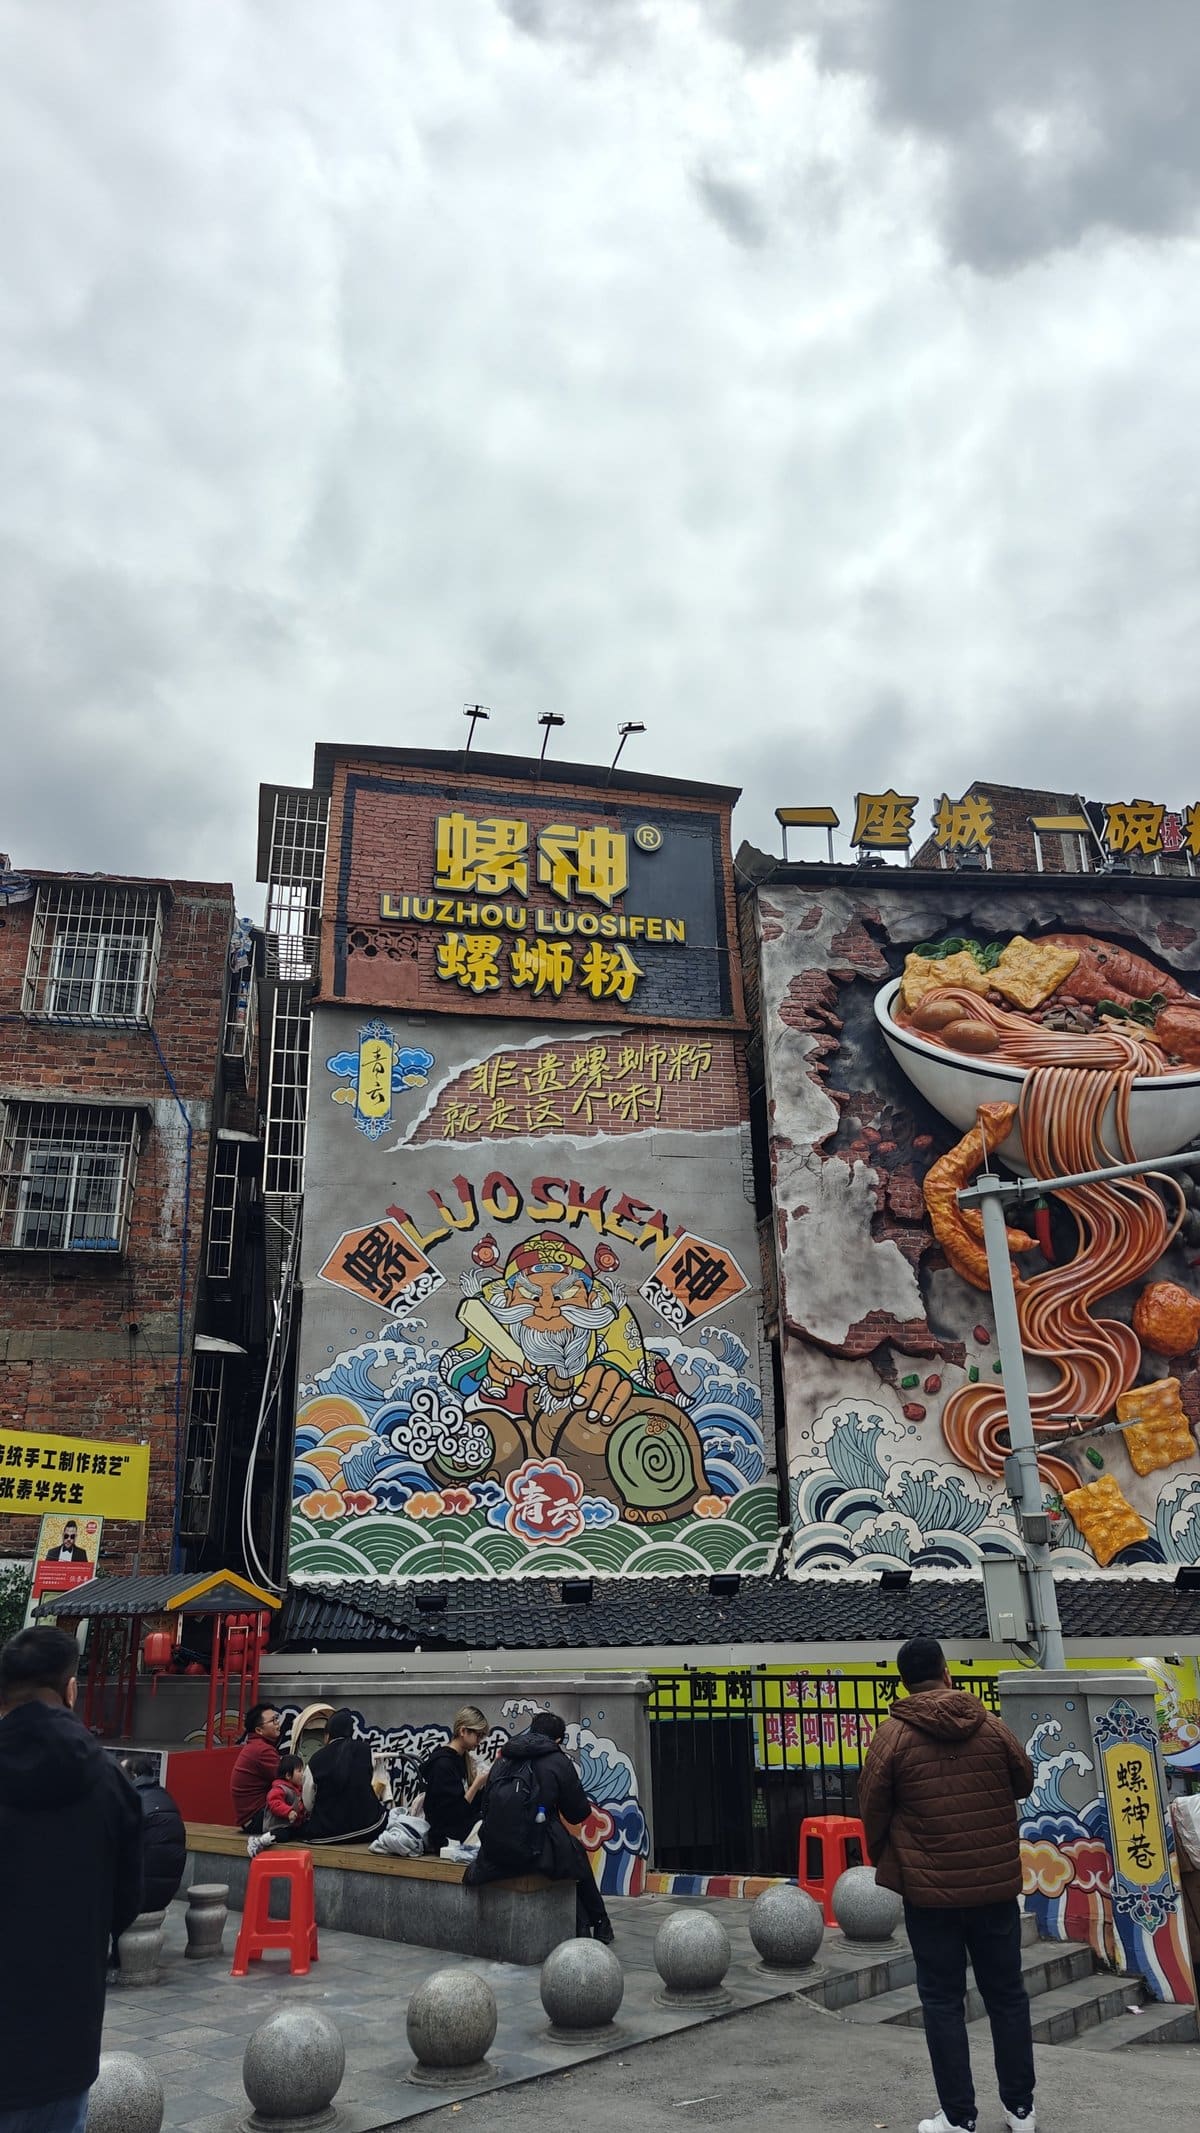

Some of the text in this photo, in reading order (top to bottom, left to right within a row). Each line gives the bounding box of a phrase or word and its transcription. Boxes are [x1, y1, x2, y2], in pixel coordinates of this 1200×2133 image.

[434, 812, 629, 908] 螺神
[381, 894, 686, 944] LIUZHOU LUOSIFEN
[435, 932, 645, 1002] 螺蛳粉
[361, 1046, 388, 1106] 青云
[469, 1042, 713, 1099] 非遗螺蛳粉
[442, 1084, 664, 1138] 就是这个味!
[386, 1171, 687, 1264] LUOSHEN
[515, 1480, 580, 1528] 青云
[764, 1712, 874, 1750] 螺蛳粉
[1115, 1760, 1156, 1870] 螺神巷
